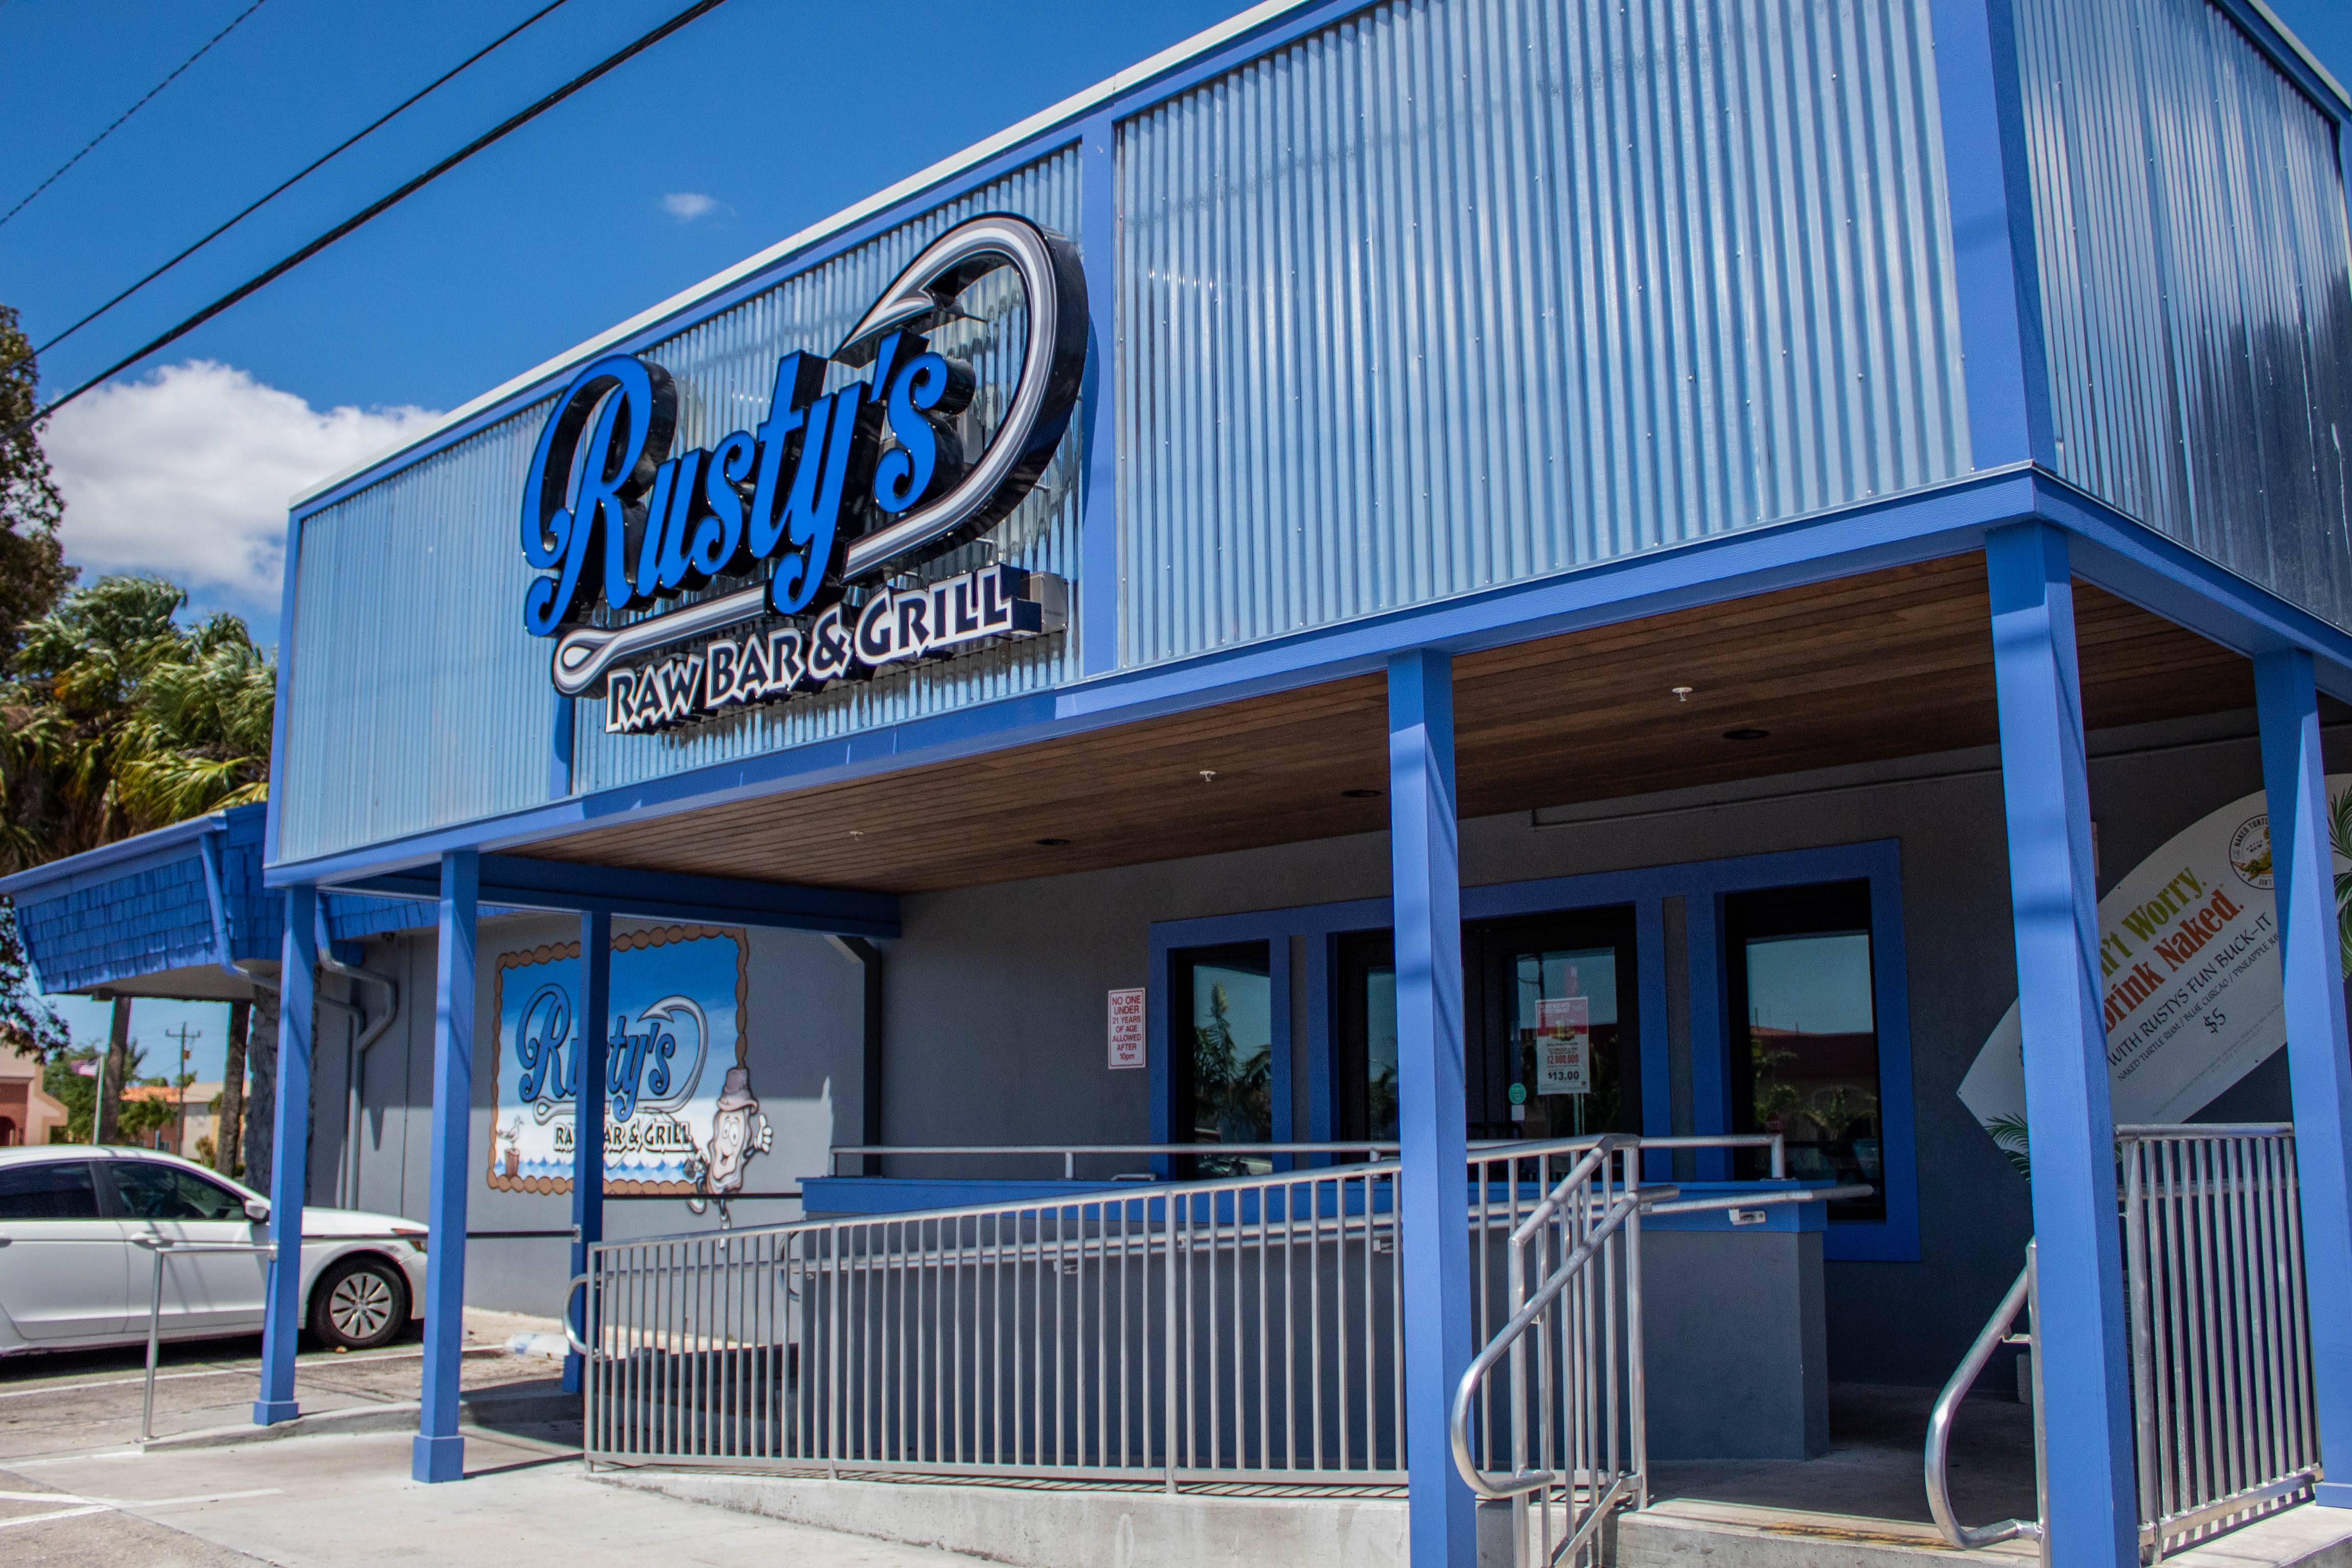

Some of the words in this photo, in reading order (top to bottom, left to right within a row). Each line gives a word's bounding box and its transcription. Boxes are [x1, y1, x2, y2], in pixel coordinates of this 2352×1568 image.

[520, 330, 947, 637] Rusty's
[608, 657, 703, 729] RAW
[713, 632, 803, 703] BAR
[814, 608, 850, 674] &
[857, 569, 1011, 659] GRILL
[2233, 827, 2249, 847] NAKED
[2248, 818, 2268, 829] TURTL
[2121, 867, 2207, 941] Worry.
[2153, 888, 2244, 972] Naked.
[1112, 997, 1123, 1005] NO
[1125, 995, 1141, 1004] ONE
[2107, 1032, 2142, 1066] WITH
[2139, 988, 2188, 1037] RUSTYS
[2186, 963, 2217, 993] FUN
[2214, 911, 2271, 967] BUCK-IT
[1114, 1005, 1139, 1014] UNDER
[2117, 1059, 2140, 1081] NAKED
[2139, 1036, 2165, 1061] TURTLE
[2163, 1023, 2181, 1040] RUM
[2183, 1003, 2203, 1021] BLUE
[2232, 942, 2269, 977] PINEAPPLE
[2203, 1007, 2225, 1033] $5
[1112, 1034, 1141, 1042] ALLOWED
[1117, 1043, 1137, 1051] AFTER
[516, 983, 676, 1122] Rty's
[1120, 1052, 1135, 1060] 10pm
[1548, 1071, 1579, 1080] $13.00
[556, 1126, 573, 1145] RA
[604, 1125, 622, 1145] AR
[629, 1123, 639, 1144] &
[645, 1122, 689, 1145] GRILL
